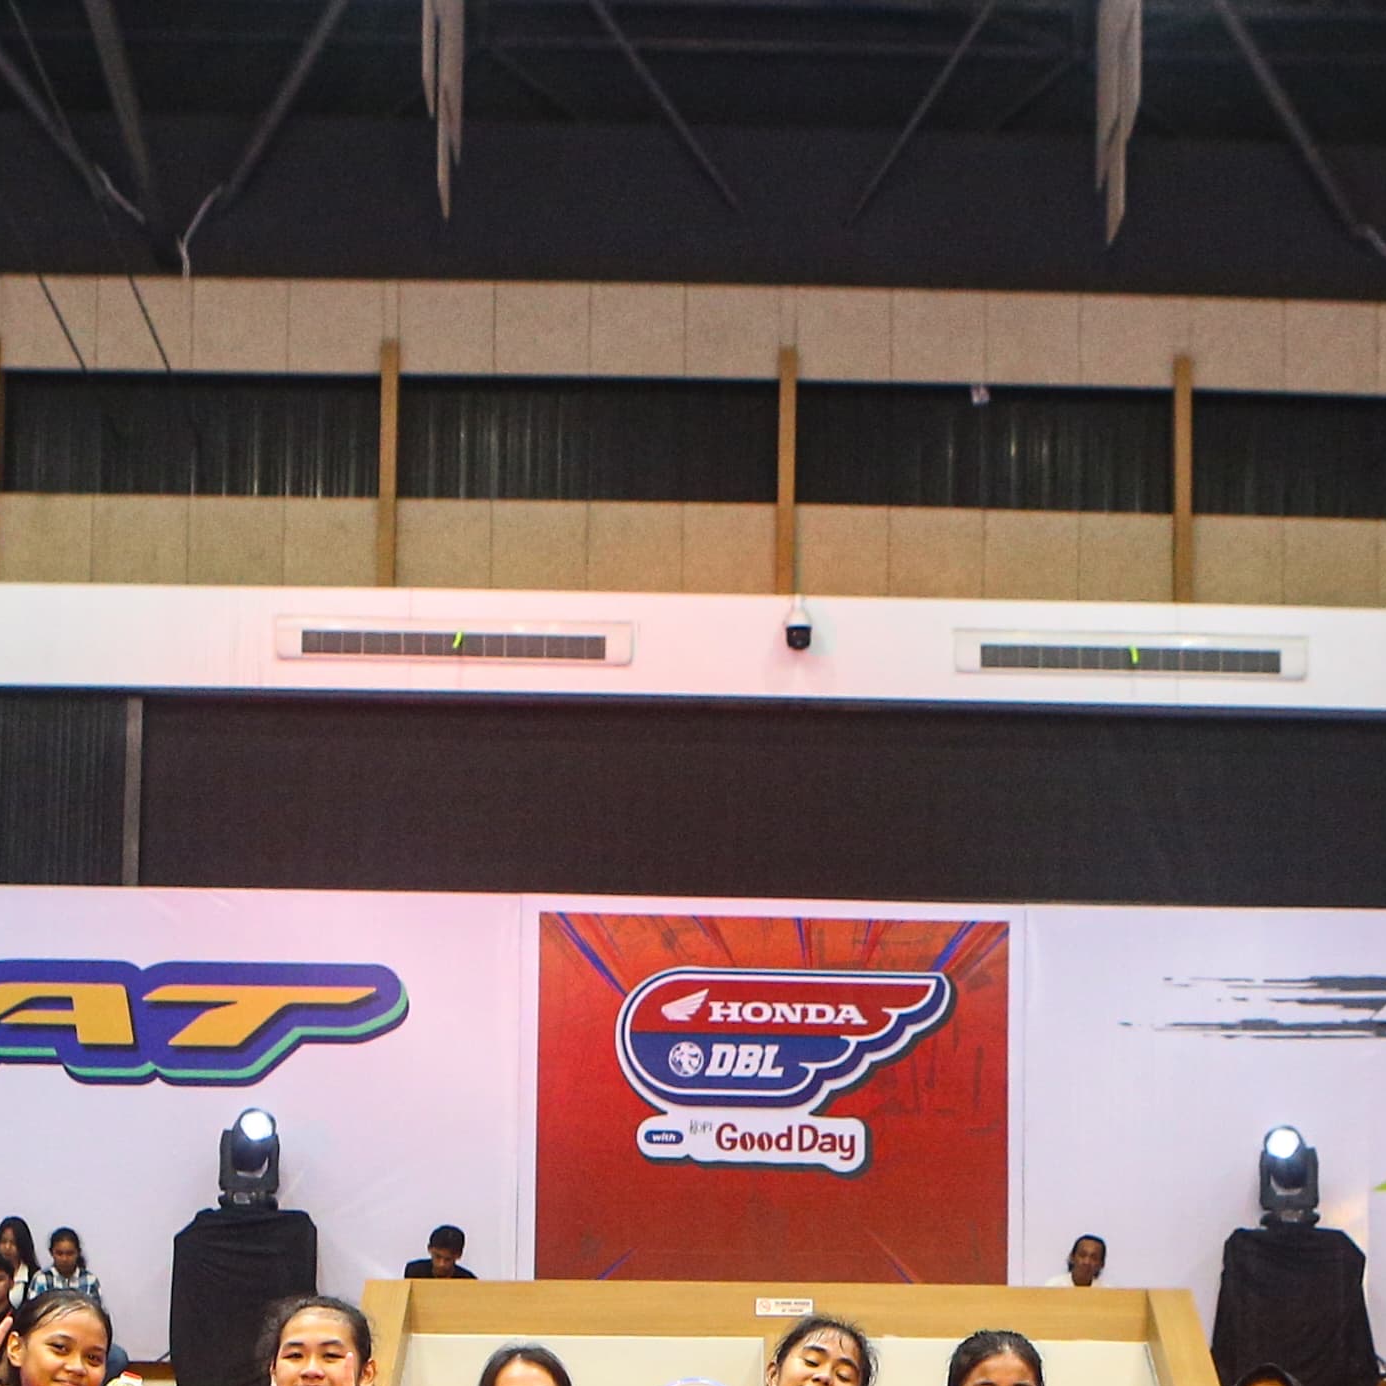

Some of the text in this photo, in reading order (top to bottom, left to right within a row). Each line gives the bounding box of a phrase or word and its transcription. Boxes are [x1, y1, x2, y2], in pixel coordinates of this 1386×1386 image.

[708, 1001, 868, 1026] HONDA
[705, 1045, 784, 1077] DBL
[651, 1132, 677, 1144] with
